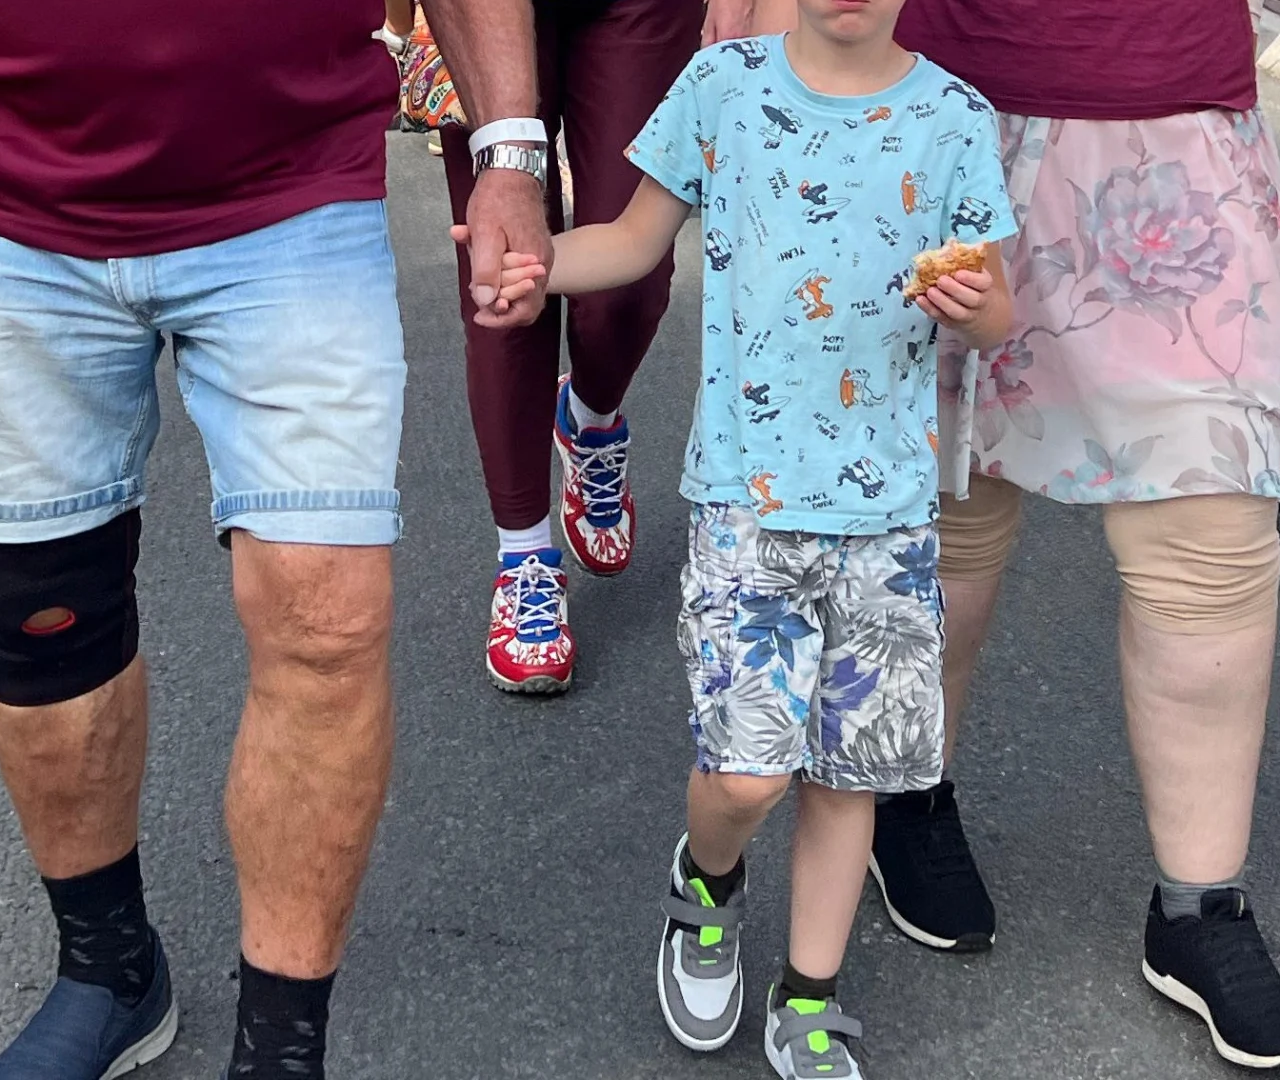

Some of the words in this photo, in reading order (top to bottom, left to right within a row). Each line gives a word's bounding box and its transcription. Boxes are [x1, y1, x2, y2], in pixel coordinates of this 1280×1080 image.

[777, 245, 806, 263] YEAH!
[851, 299, 876, 310] PEACE
[800, 491, 828, 504] PEACE
